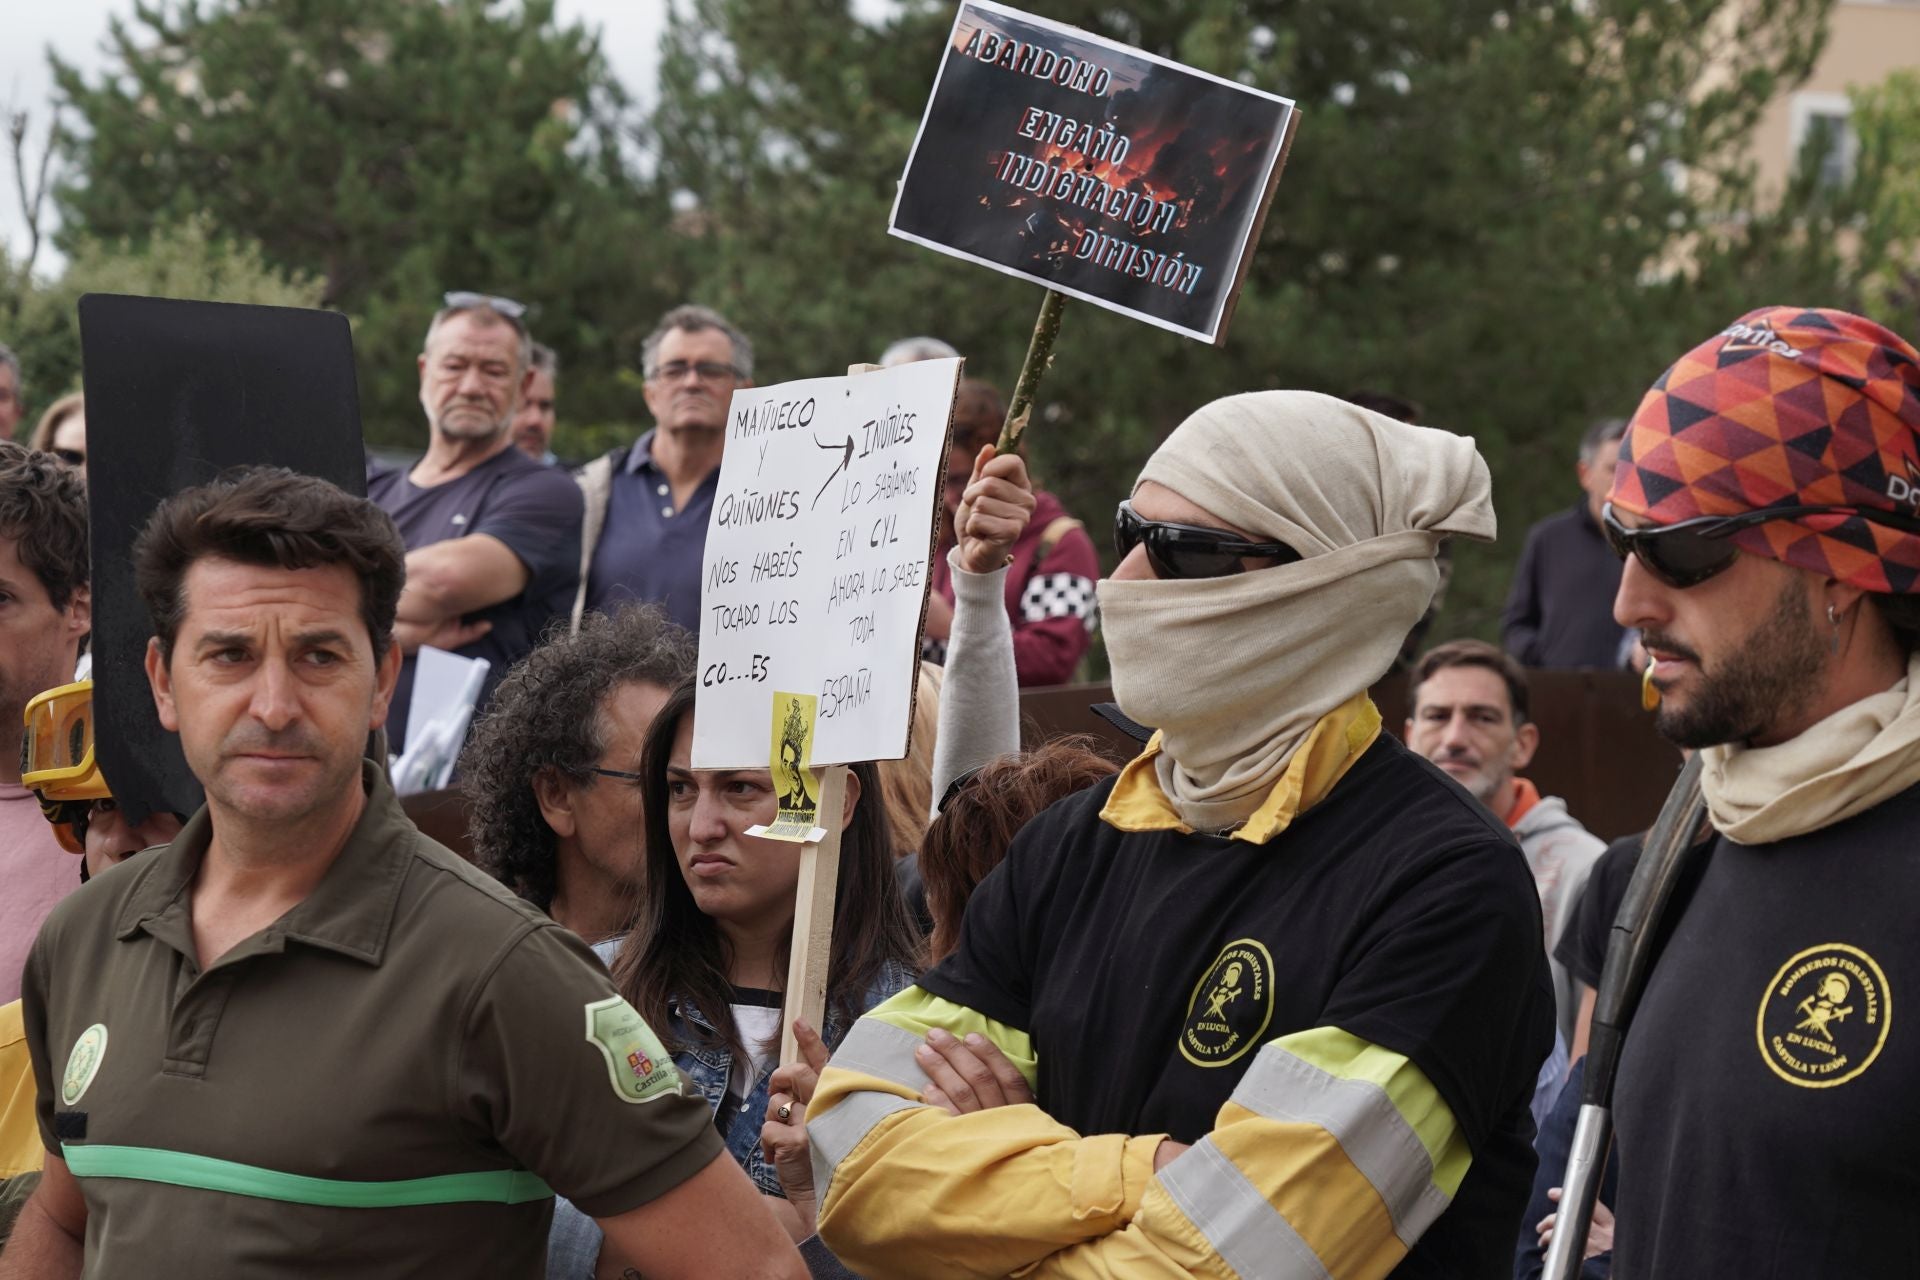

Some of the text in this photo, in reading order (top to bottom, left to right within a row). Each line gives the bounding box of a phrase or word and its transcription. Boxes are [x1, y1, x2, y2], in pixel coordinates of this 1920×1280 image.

[964, 28, 1112, 97] ABANDONO
[1018, 106, 1131, 166] ENGAÑO
[997, 151, 1178, 234] INDIGNACIÓN
[1072, 228, 1203, 295] DIMISIÓN
[734, 397, 816, 439] MAÑUECO
[758, 440, 768, 476] Y
[719, 488, 799, 529] QUIÑONES
[841, 478, 861, 514] LO
[836, 514, 898, 560] EN CYL
[708, 556, 738, 593] NOS
[828, 561, 924, 614] AHORA LO SABE
[712, 600, 799, 636] TOCADO LOS
[849, 610, 875, 647] TODA
[819, 668, 872, 718] ESPAÑA
[1238, 950, 1262, 1000] FORESTALES
[1780, 957, 1877, 1024] BOMBEROS FORESTALES
[1187, 1028, 1212, 1055] CASTILLA
[1214, 1046, 1222, 1054] Y
[1206, 1023, 1230, 1033] LUCHA
[1786, 1032, 1837, 1055] EN LUCHA
[1772, 1035, 1807, 1073] CASTILLA
[1810, 1064, 1819, 1074] Y
[635, 1070, 668, 1092] Castilla
